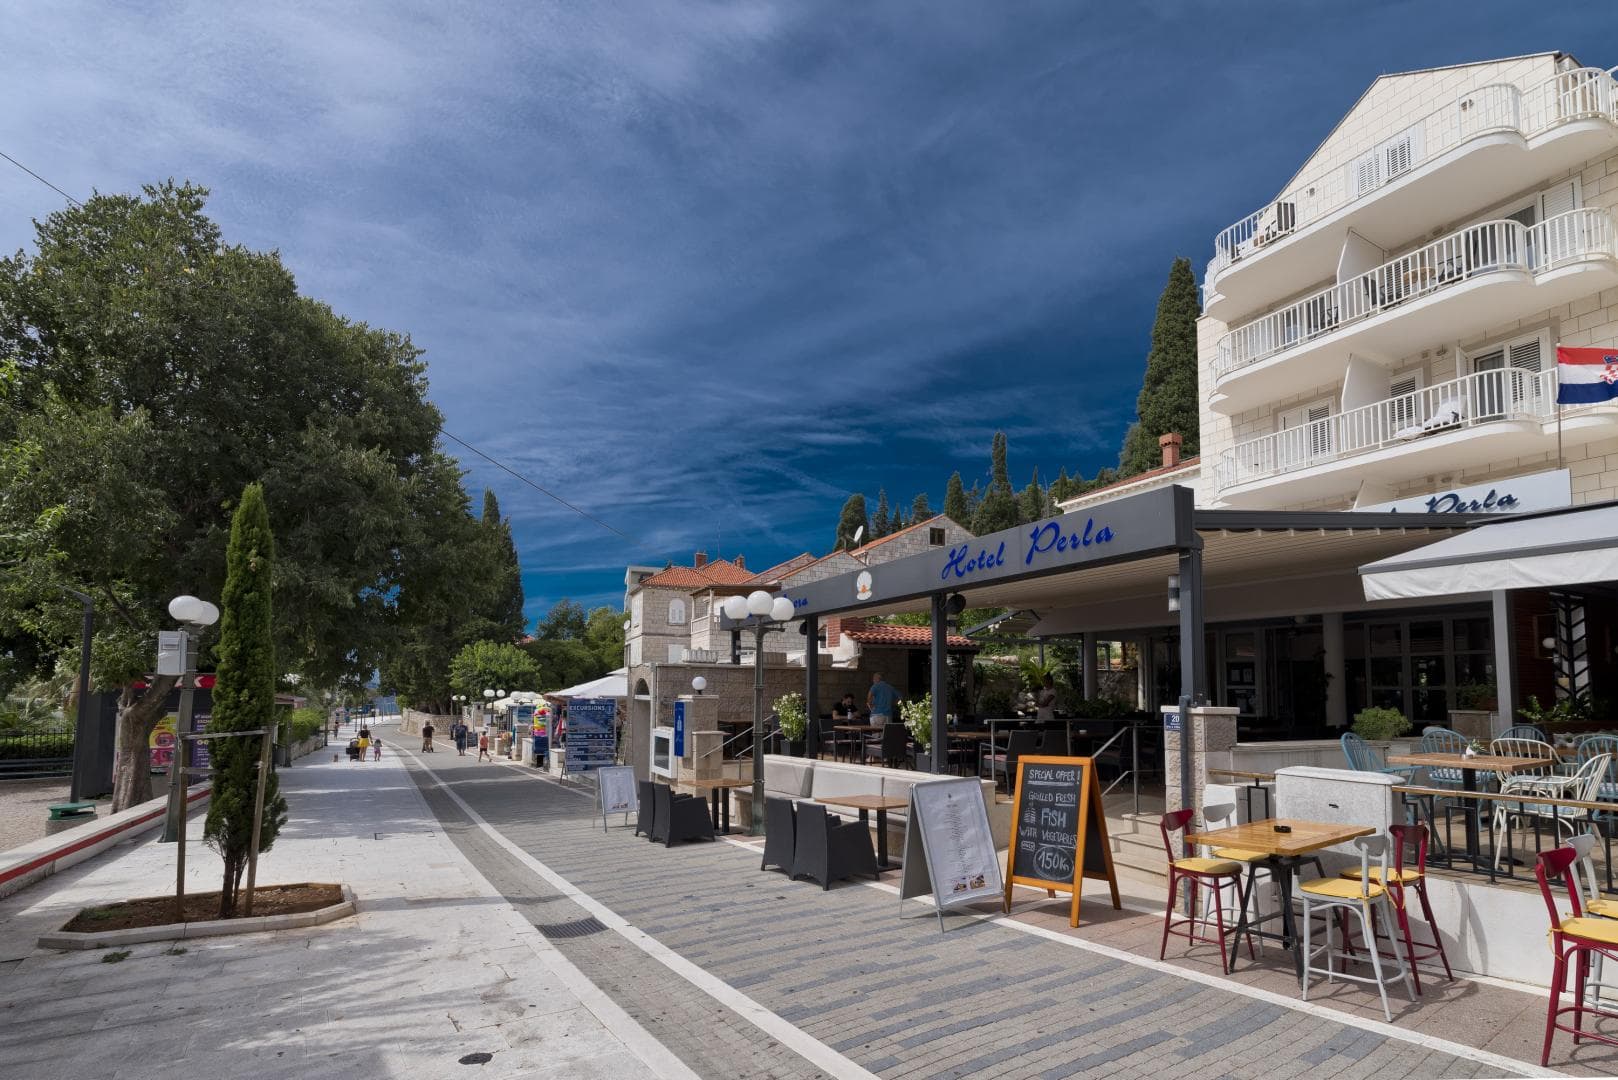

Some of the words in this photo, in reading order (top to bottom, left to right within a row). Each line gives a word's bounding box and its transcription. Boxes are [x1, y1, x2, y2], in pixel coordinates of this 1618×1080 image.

[942, 541, 1005, 580] Hotel
[1025, 517, 1114, 565] Perla
[1171, 714, 1180, 722] 20
[1028, 769, 1054, 780] SPECIAL
[1041, 829, 1078, 848] VEGETABLES
